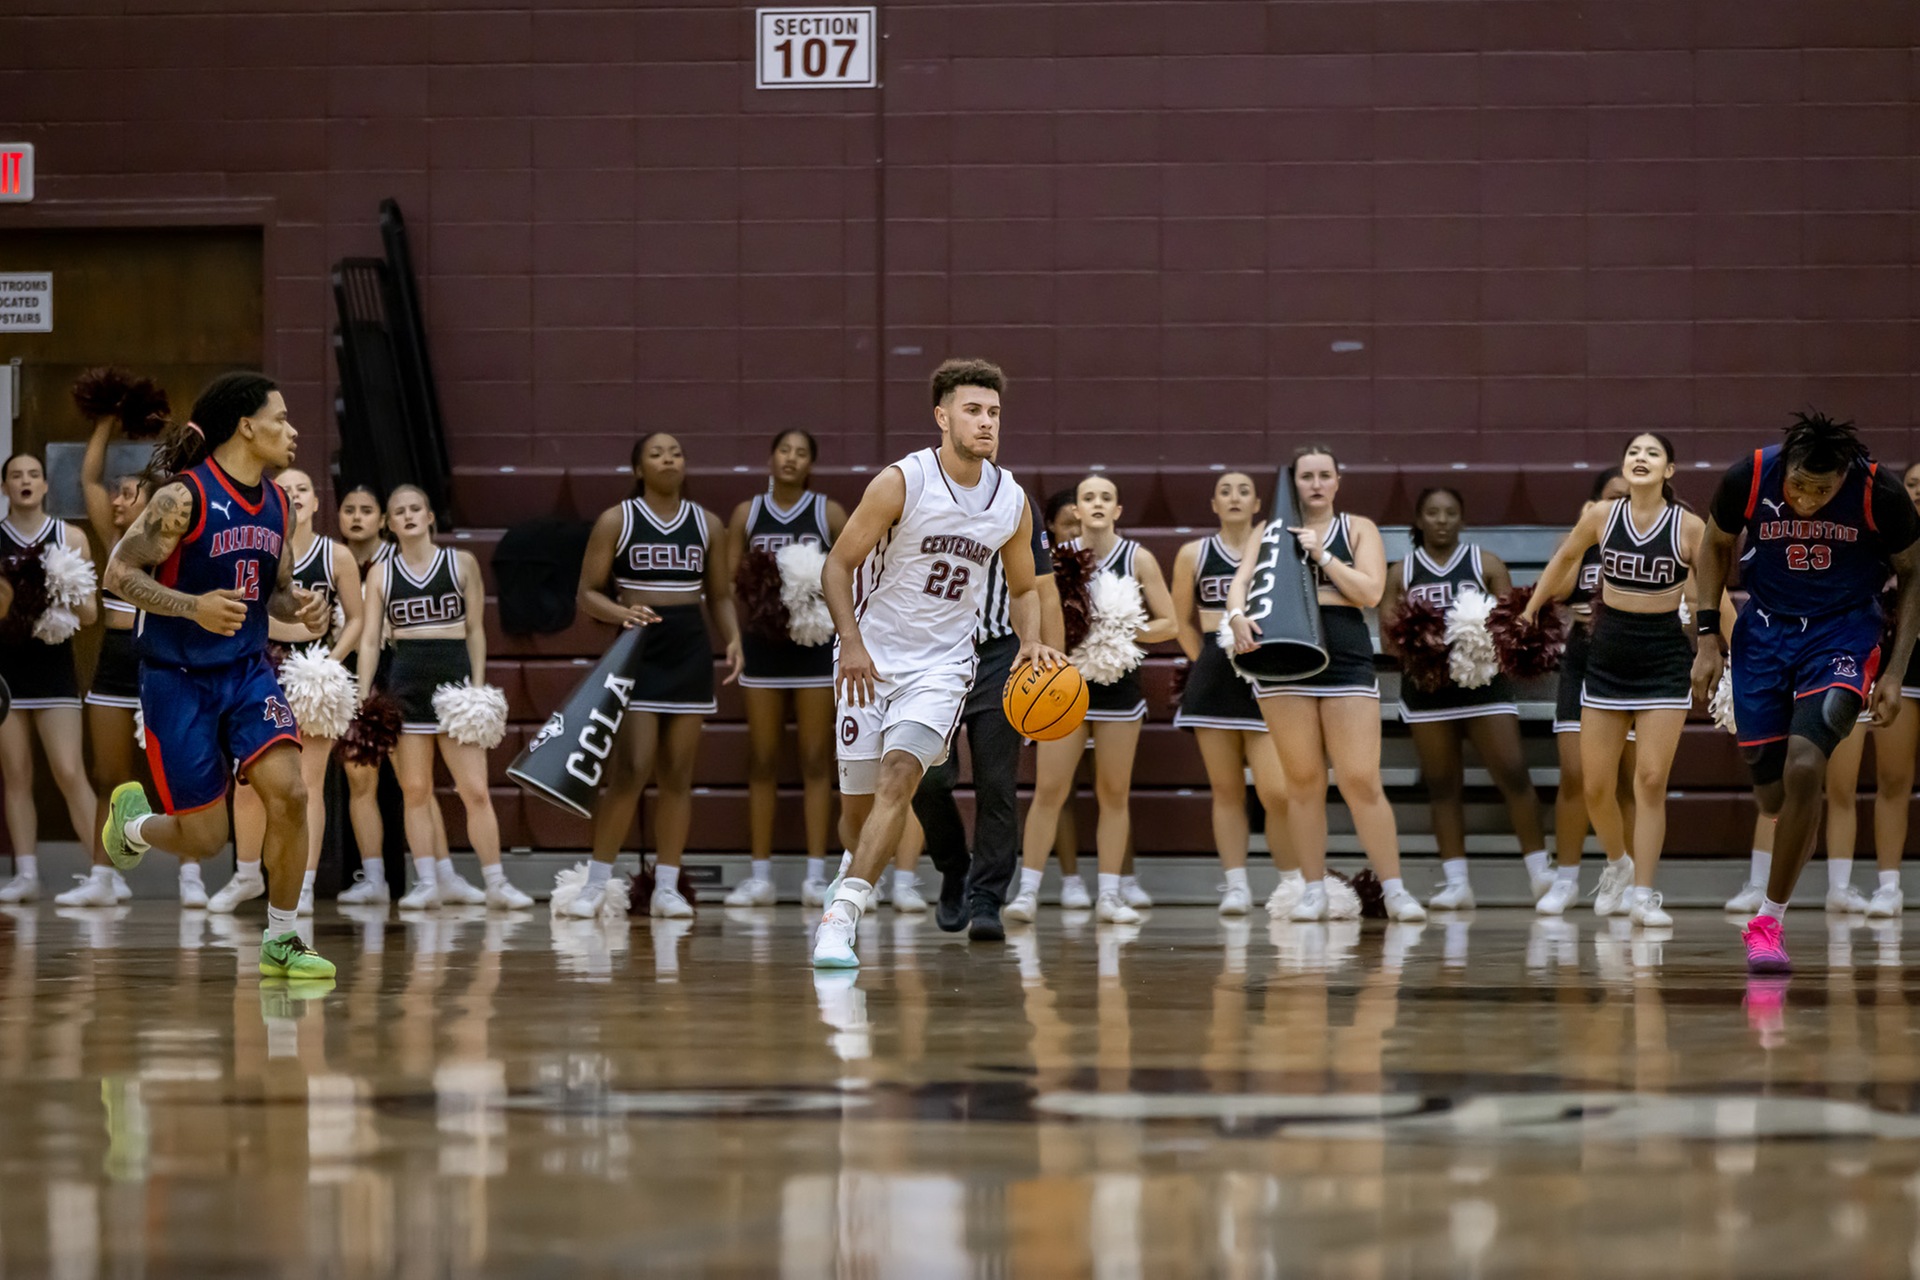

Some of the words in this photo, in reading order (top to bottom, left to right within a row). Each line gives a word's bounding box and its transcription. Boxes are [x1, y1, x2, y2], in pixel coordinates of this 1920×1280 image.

[773, 17, 858, 36] SECTION
[773, 38, 858, 78] 107
[0, 281, 48, 291] TROOMS
[0, 313, 41, 325] STAIRS
[209, 525, 282, 559] ARLINGTON
[1759, 520, 1858, 542] ARLINGTON
[629, 543, 704, 573] CCLA
[1602, 548, 1675, 584] CCLA
[1785, 543, 1832, 571] 23
[235, 559, 259, 601] 12
[923, 559, 970, 602] 22
[389, 593, 461, 626] CCLA
[565, 671, 636, 787] CCLA
